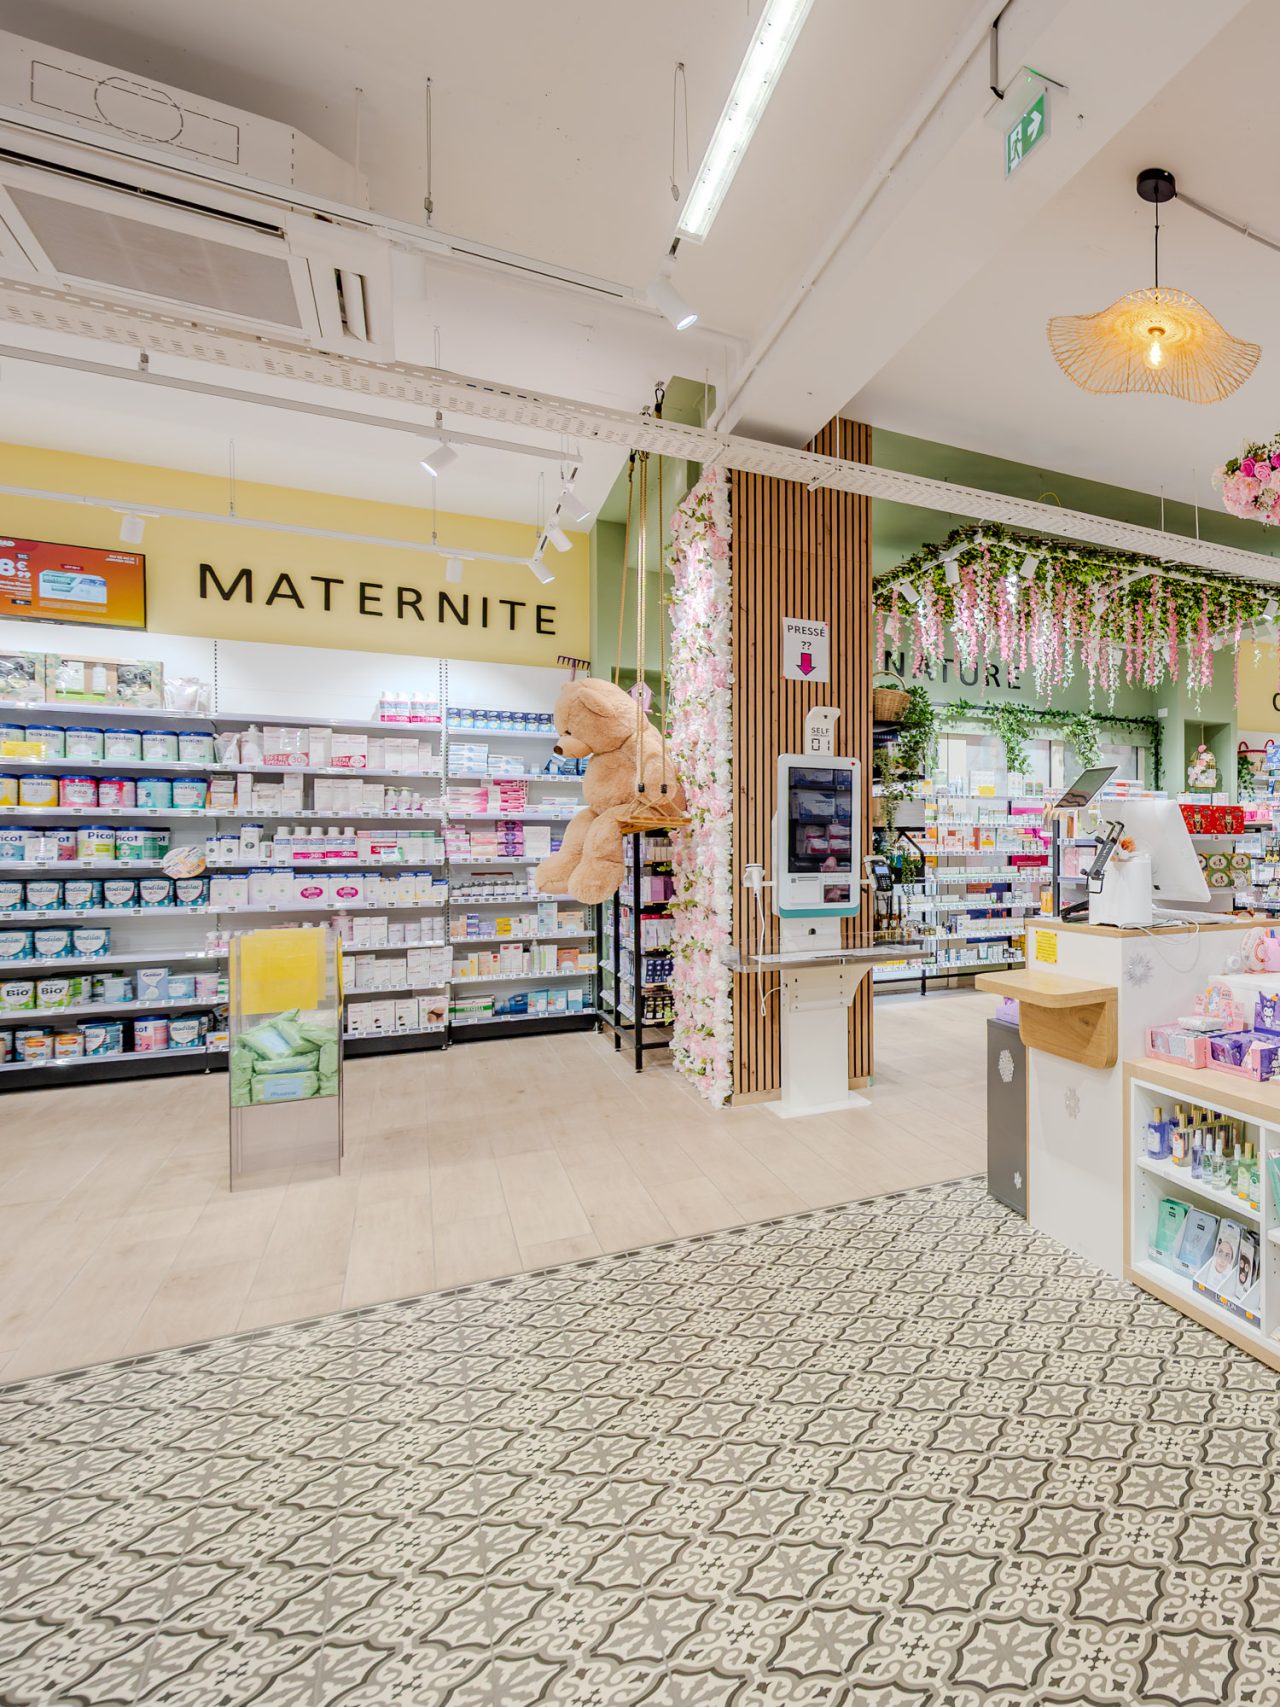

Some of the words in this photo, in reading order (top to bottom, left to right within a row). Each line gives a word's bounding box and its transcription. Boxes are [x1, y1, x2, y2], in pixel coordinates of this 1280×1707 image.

[200, 562, 556, 636] MATERNITE
[787, 624, 826, 638] PRESSÉ
[801, 640, 812, 650] ??
[811, 727, 830, 735] SELF
[0, 834, 23, 843] icot
